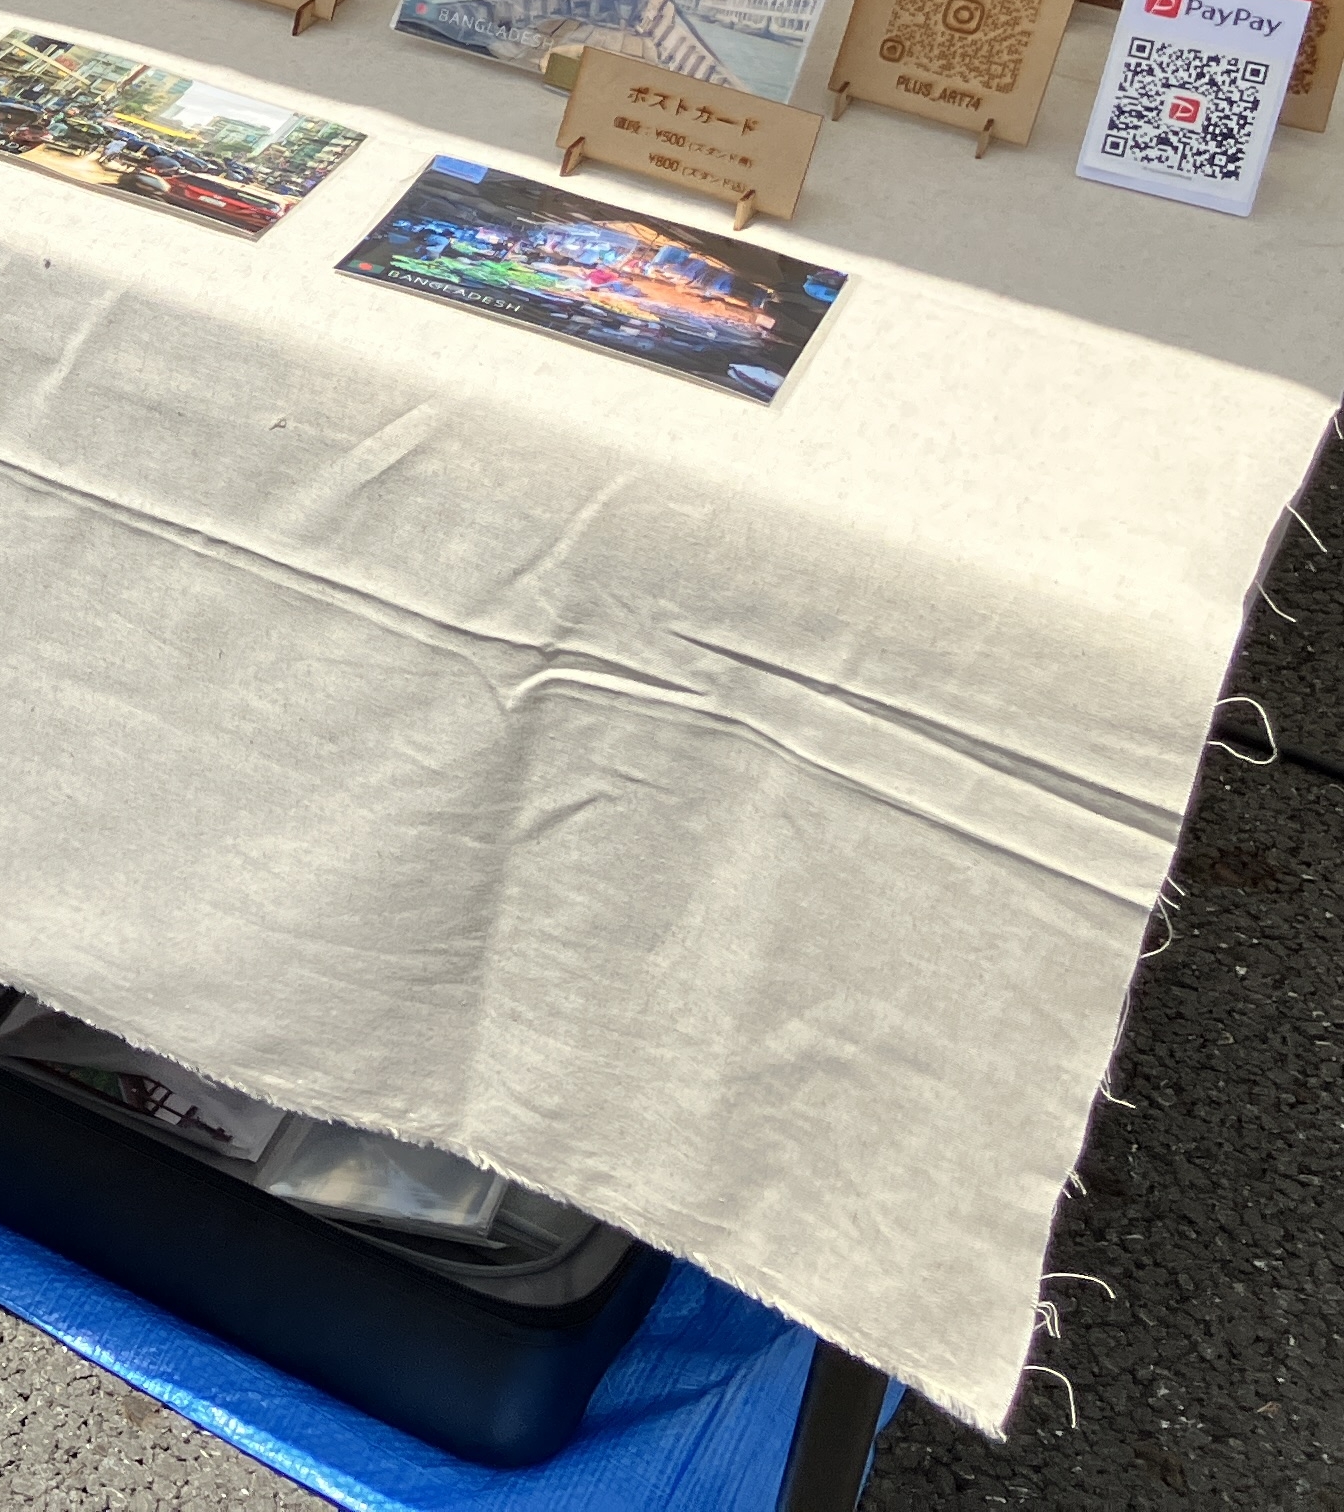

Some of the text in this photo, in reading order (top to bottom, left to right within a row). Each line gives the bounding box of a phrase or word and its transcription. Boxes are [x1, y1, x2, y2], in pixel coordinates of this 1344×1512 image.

[438, 7, 555, 52] BANGLADESH
[627, 86, 760, 137] ポストカード
[896, 74, 983, 112] PLUS_ART74
[388, 269, 521, 313] BANGLADESH
